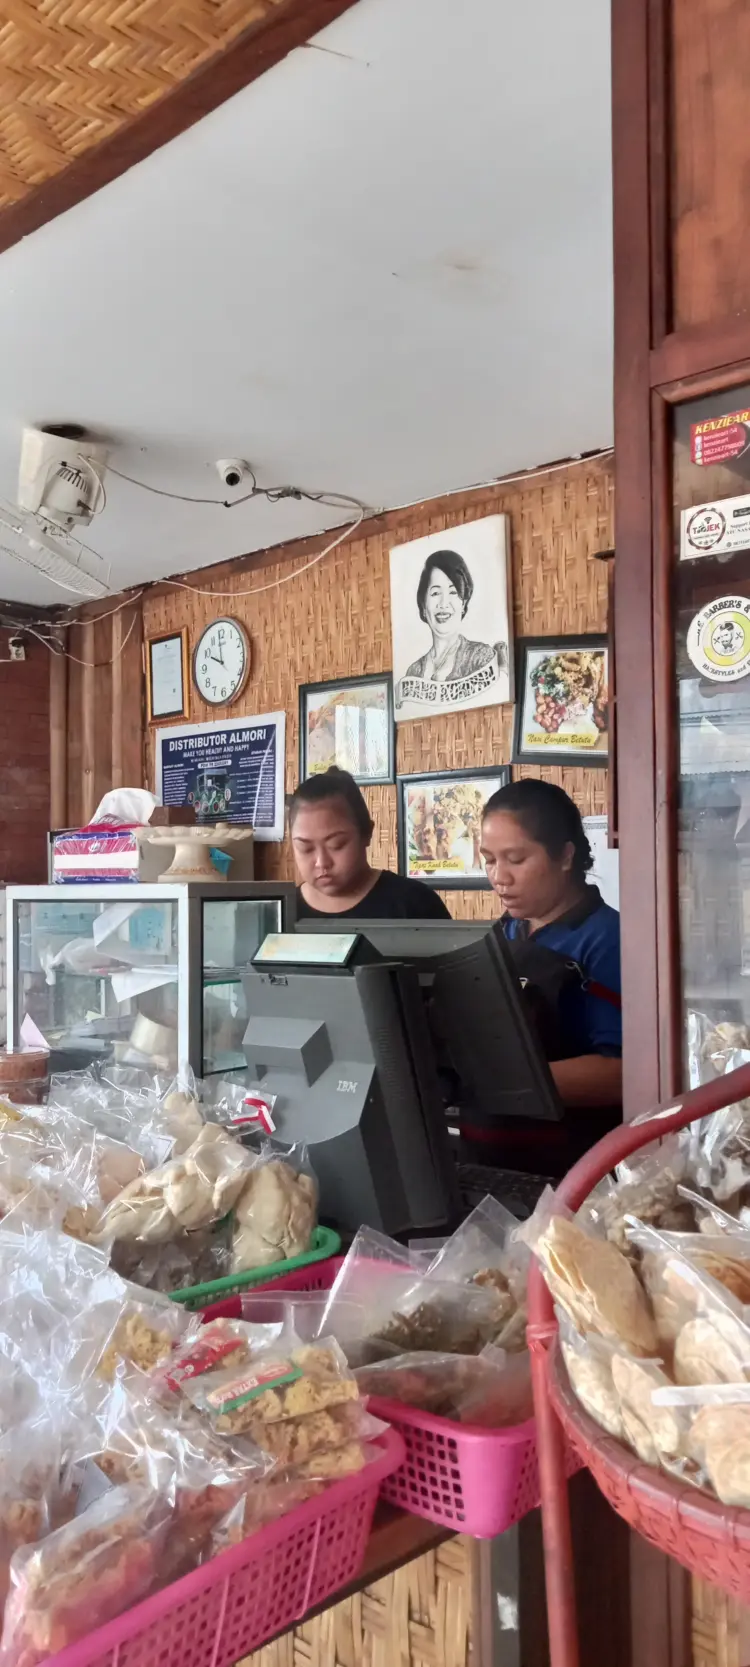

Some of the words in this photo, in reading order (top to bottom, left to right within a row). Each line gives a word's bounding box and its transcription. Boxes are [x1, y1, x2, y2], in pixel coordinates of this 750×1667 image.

[204, 648, 211, 659] 10
[201, 664, 207, 675] 9
[205, 678, 211, 688] 8
[231, 681, 236, 691] 5
[212, 686, 217, 696] 7
[221, 687, 226, 698] 6
[169, 734, 227, 752] DISTRIBUTOR
[229, 729, 267, 744] ALMORI
[223, 745, 235, 753] AND
[235, 743, 250, 752] HAPPY
[336, 1080, 358, 1094] IBM
